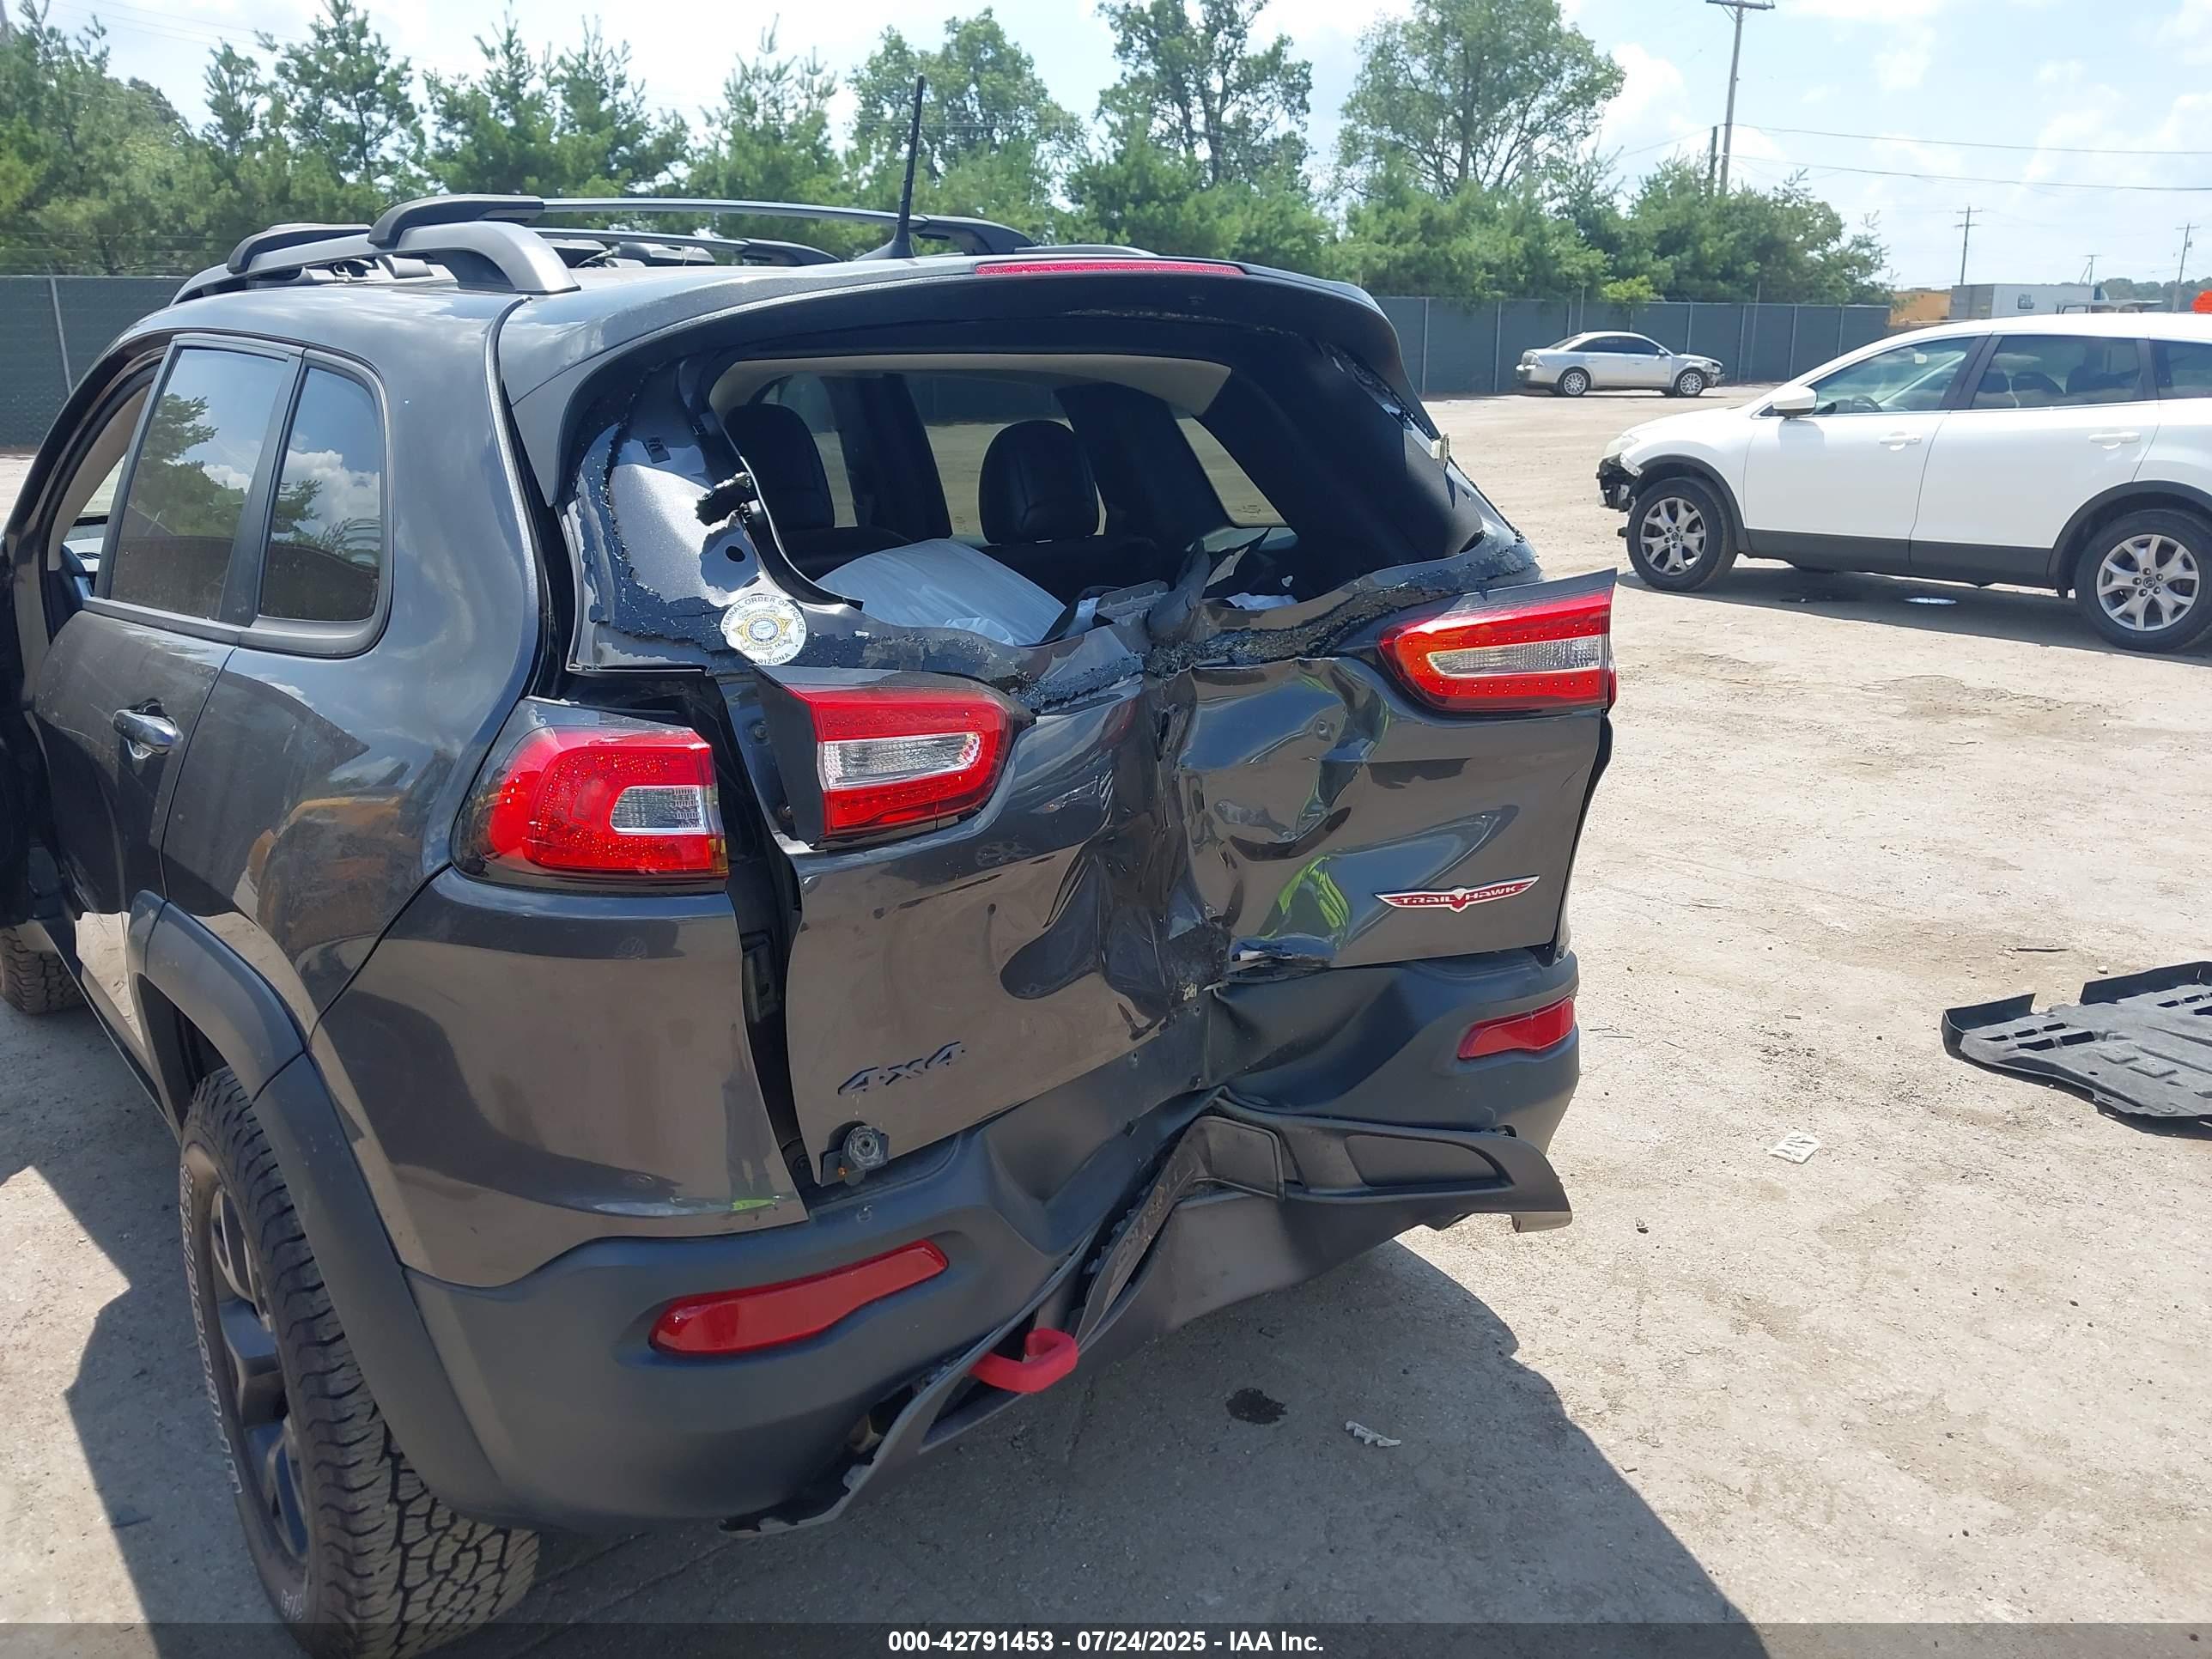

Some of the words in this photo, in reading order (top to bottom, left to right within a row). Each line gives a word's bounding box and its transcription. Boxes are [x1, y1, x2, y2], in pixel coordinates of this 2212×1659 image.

[744, 596, 776, 605] ORDER
[789, 607, 805, 634] POLICE
[1466, 886, 1518, 900] HAWK
[837, 1041, 966, 1095] 4x4
